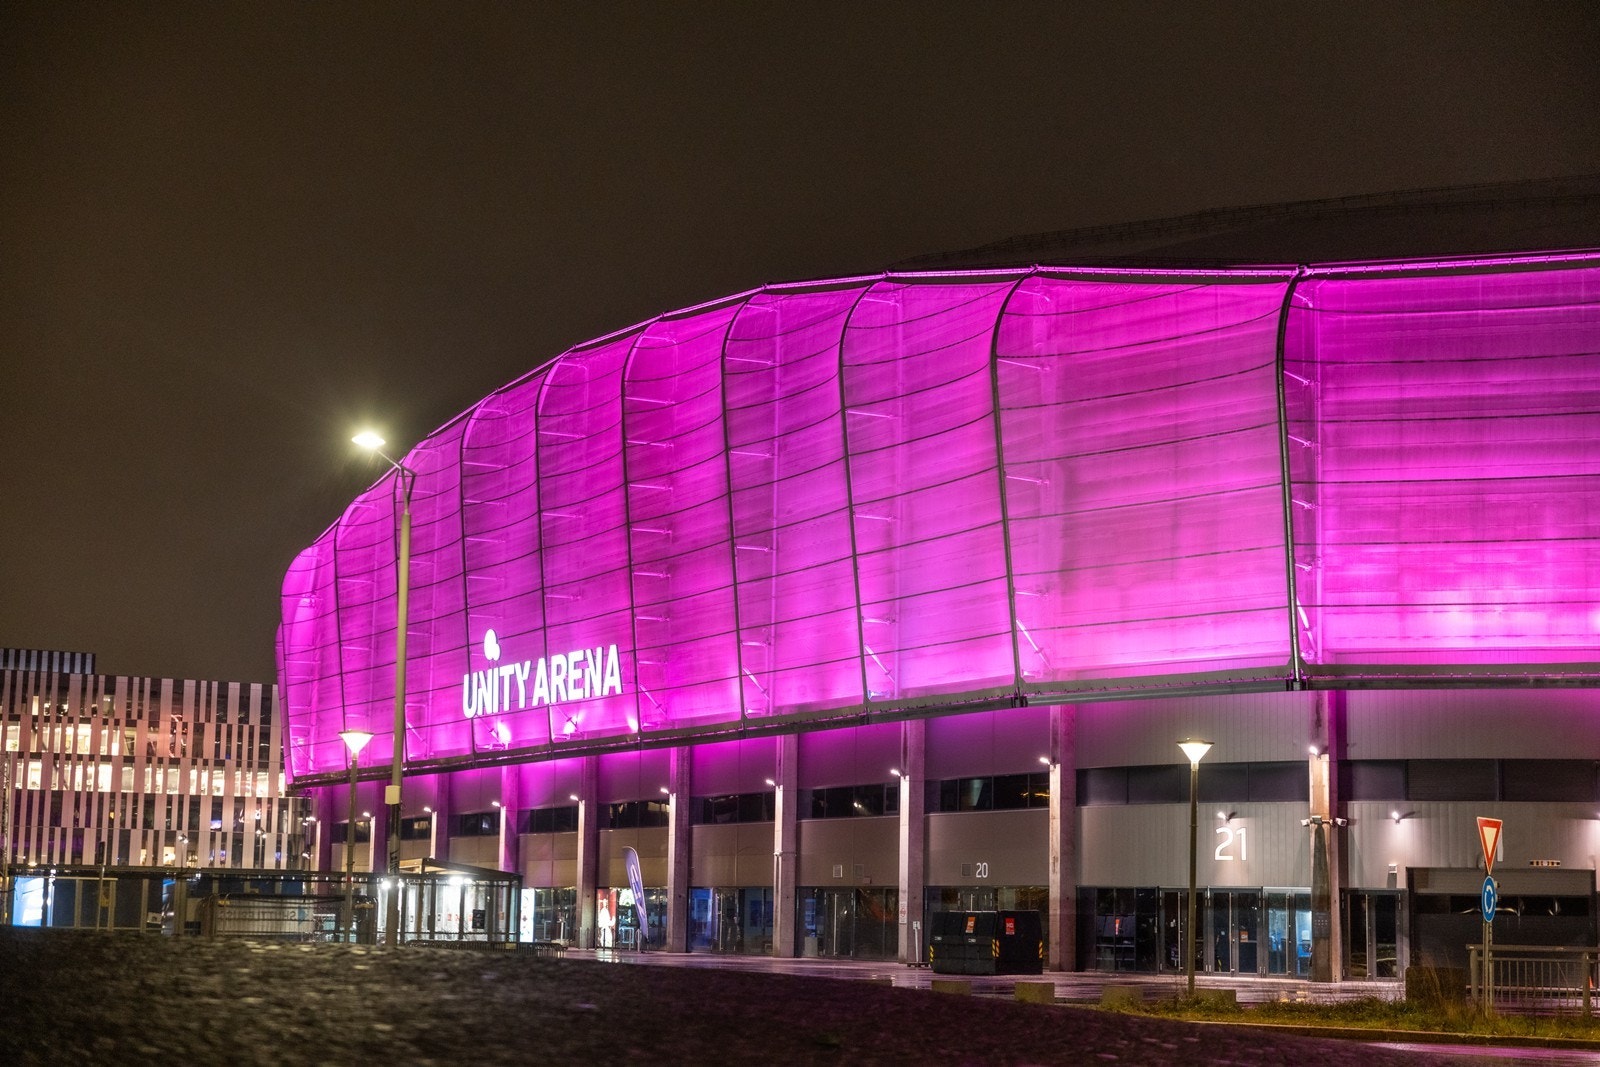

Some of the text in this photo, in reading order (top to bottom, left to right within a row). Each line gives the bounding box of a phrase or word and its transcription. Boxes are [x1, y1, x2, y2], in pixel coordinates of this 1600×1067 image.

[463, 644, 623, 719] UNITY ARENA
[1214, 826, 1248, 861] 21
[975, 862, 989, 879] 20
